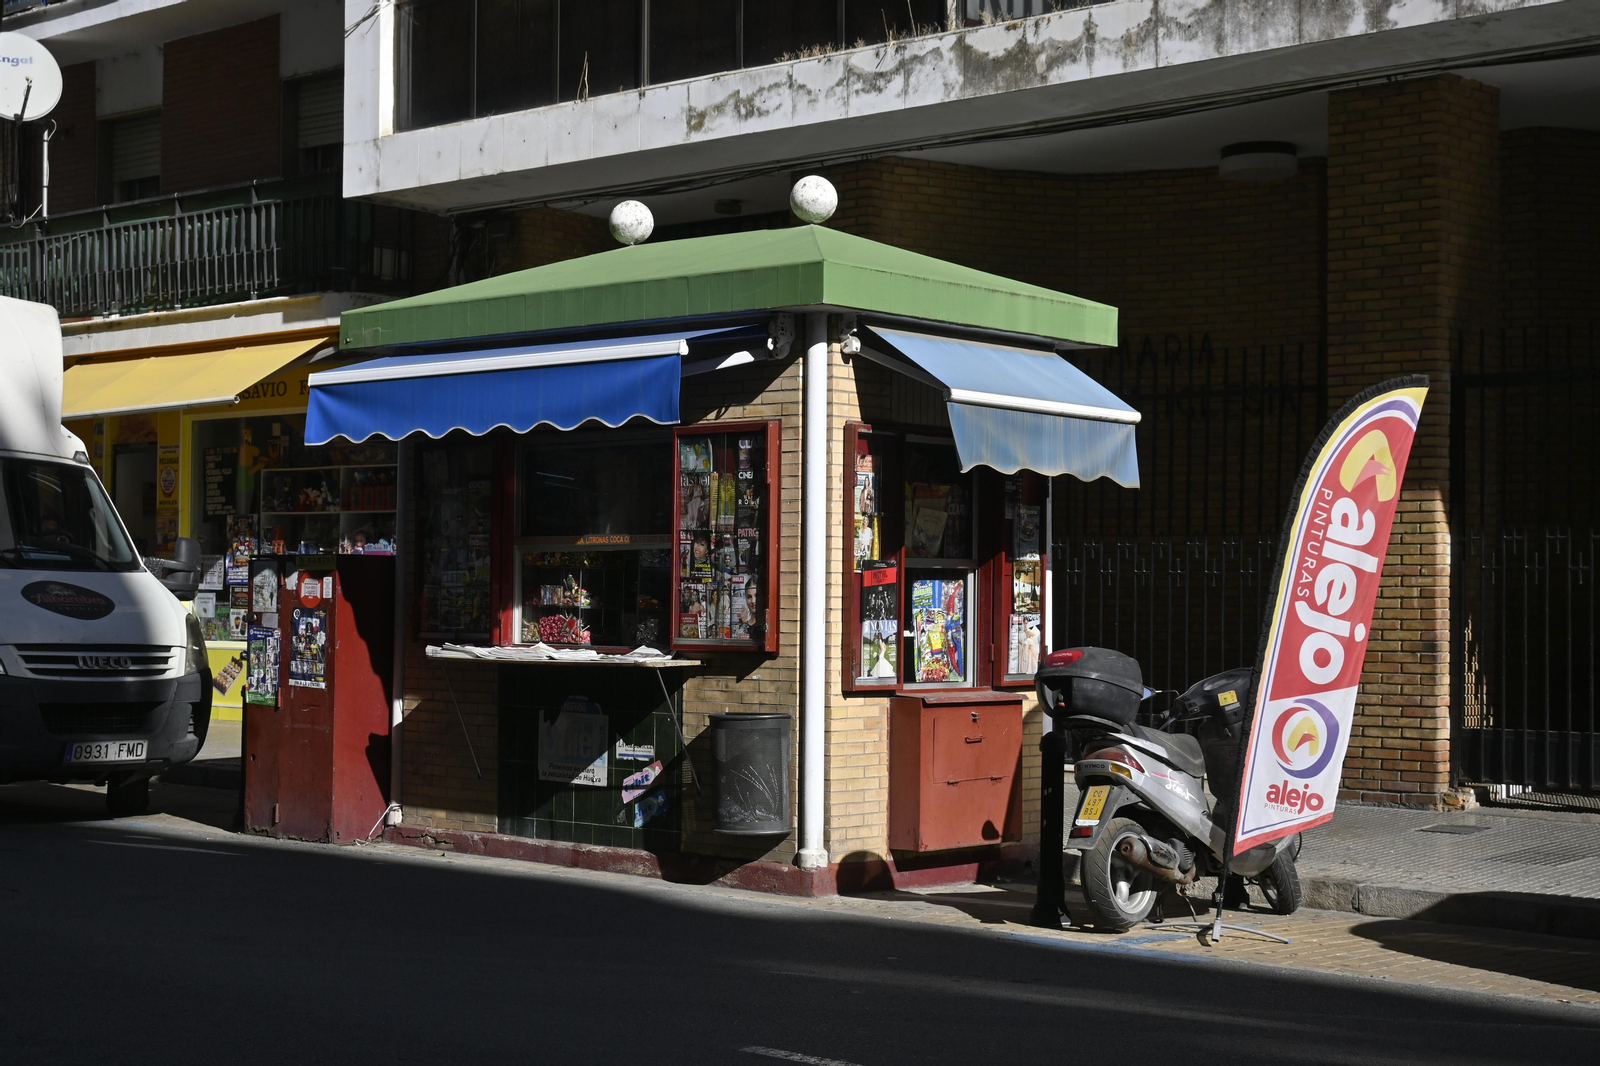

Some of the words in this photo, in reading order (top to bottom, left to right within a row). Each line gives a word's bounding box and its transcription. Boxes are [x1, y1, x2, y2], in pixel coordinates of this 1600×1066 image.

[0, 55, 33, 67] ngel
[299, 379, 310, 395] F
[585, 536, 609, 544] LITRONAS
[610, 535, 623, 543] COCA
[1297, 487, 1333, 598] PINTURAS
[1295, 497, 1379, 685] alejo
[76, 656, 132, 668] IVECO
[74, 744, 109, 760] 0931
[117, 742, 144, 758] FMD
[549, 763, 573, 772] Ponemos
[548, 771, 574, 780] actualidad
[1266, 780, 1325, 815] alejo
[1264, 803, 1297, 815] PINTURAS
